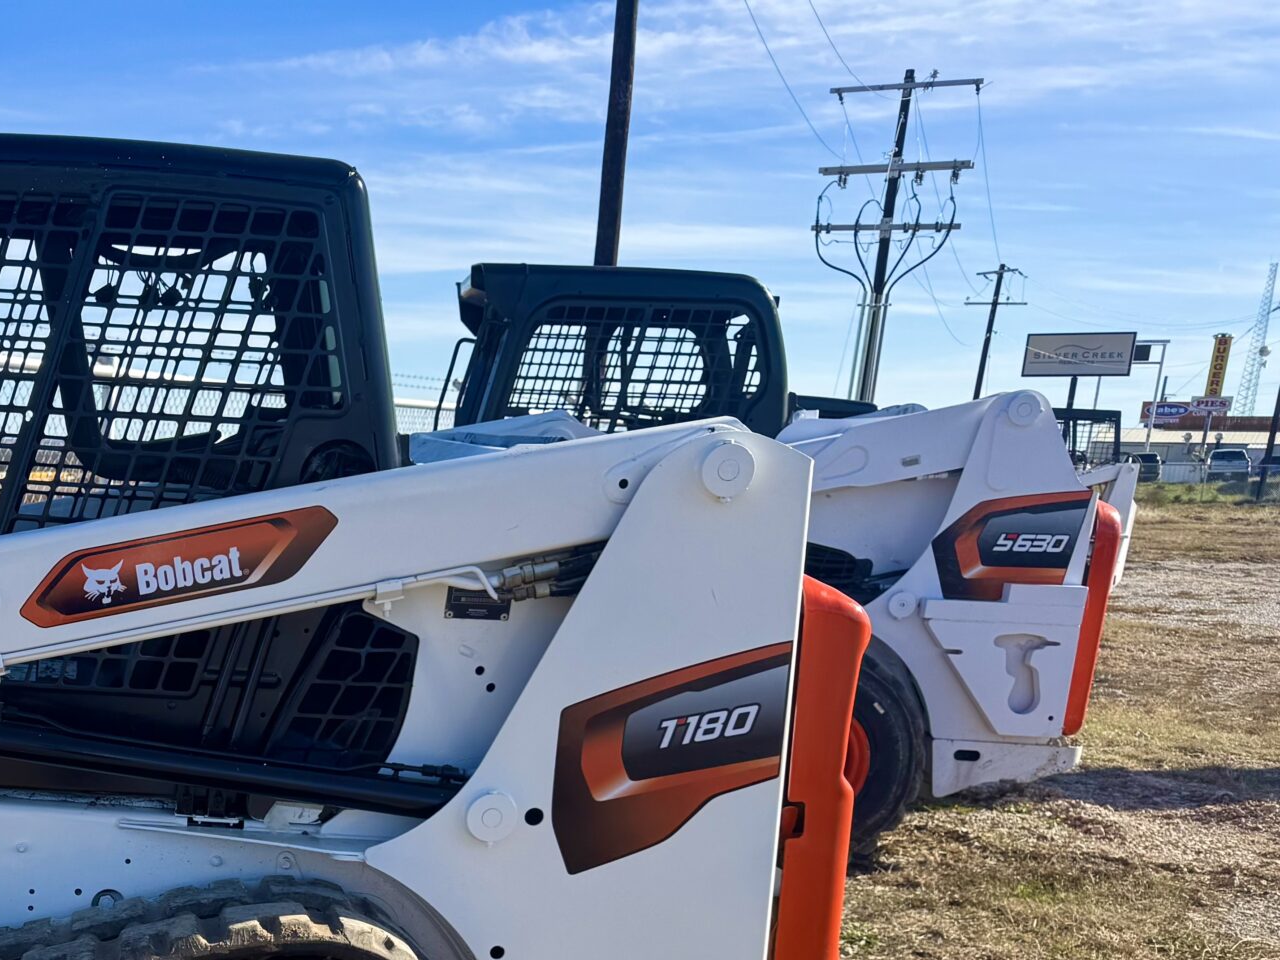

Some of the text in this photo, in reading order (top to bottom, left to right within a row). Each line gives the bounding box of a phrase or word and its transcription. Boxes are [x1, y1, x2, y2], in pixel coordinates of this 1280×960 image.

[1081, 350, 1124, 360] CREEK
[1209, 338, 1228, 395] BURGERS
[1196, 400, 1227, 408] PIES
[992, 533, 1070, 553] S630
[135, 546, 243, 596] Bobcat
[659, 704, 759, 749] T180
